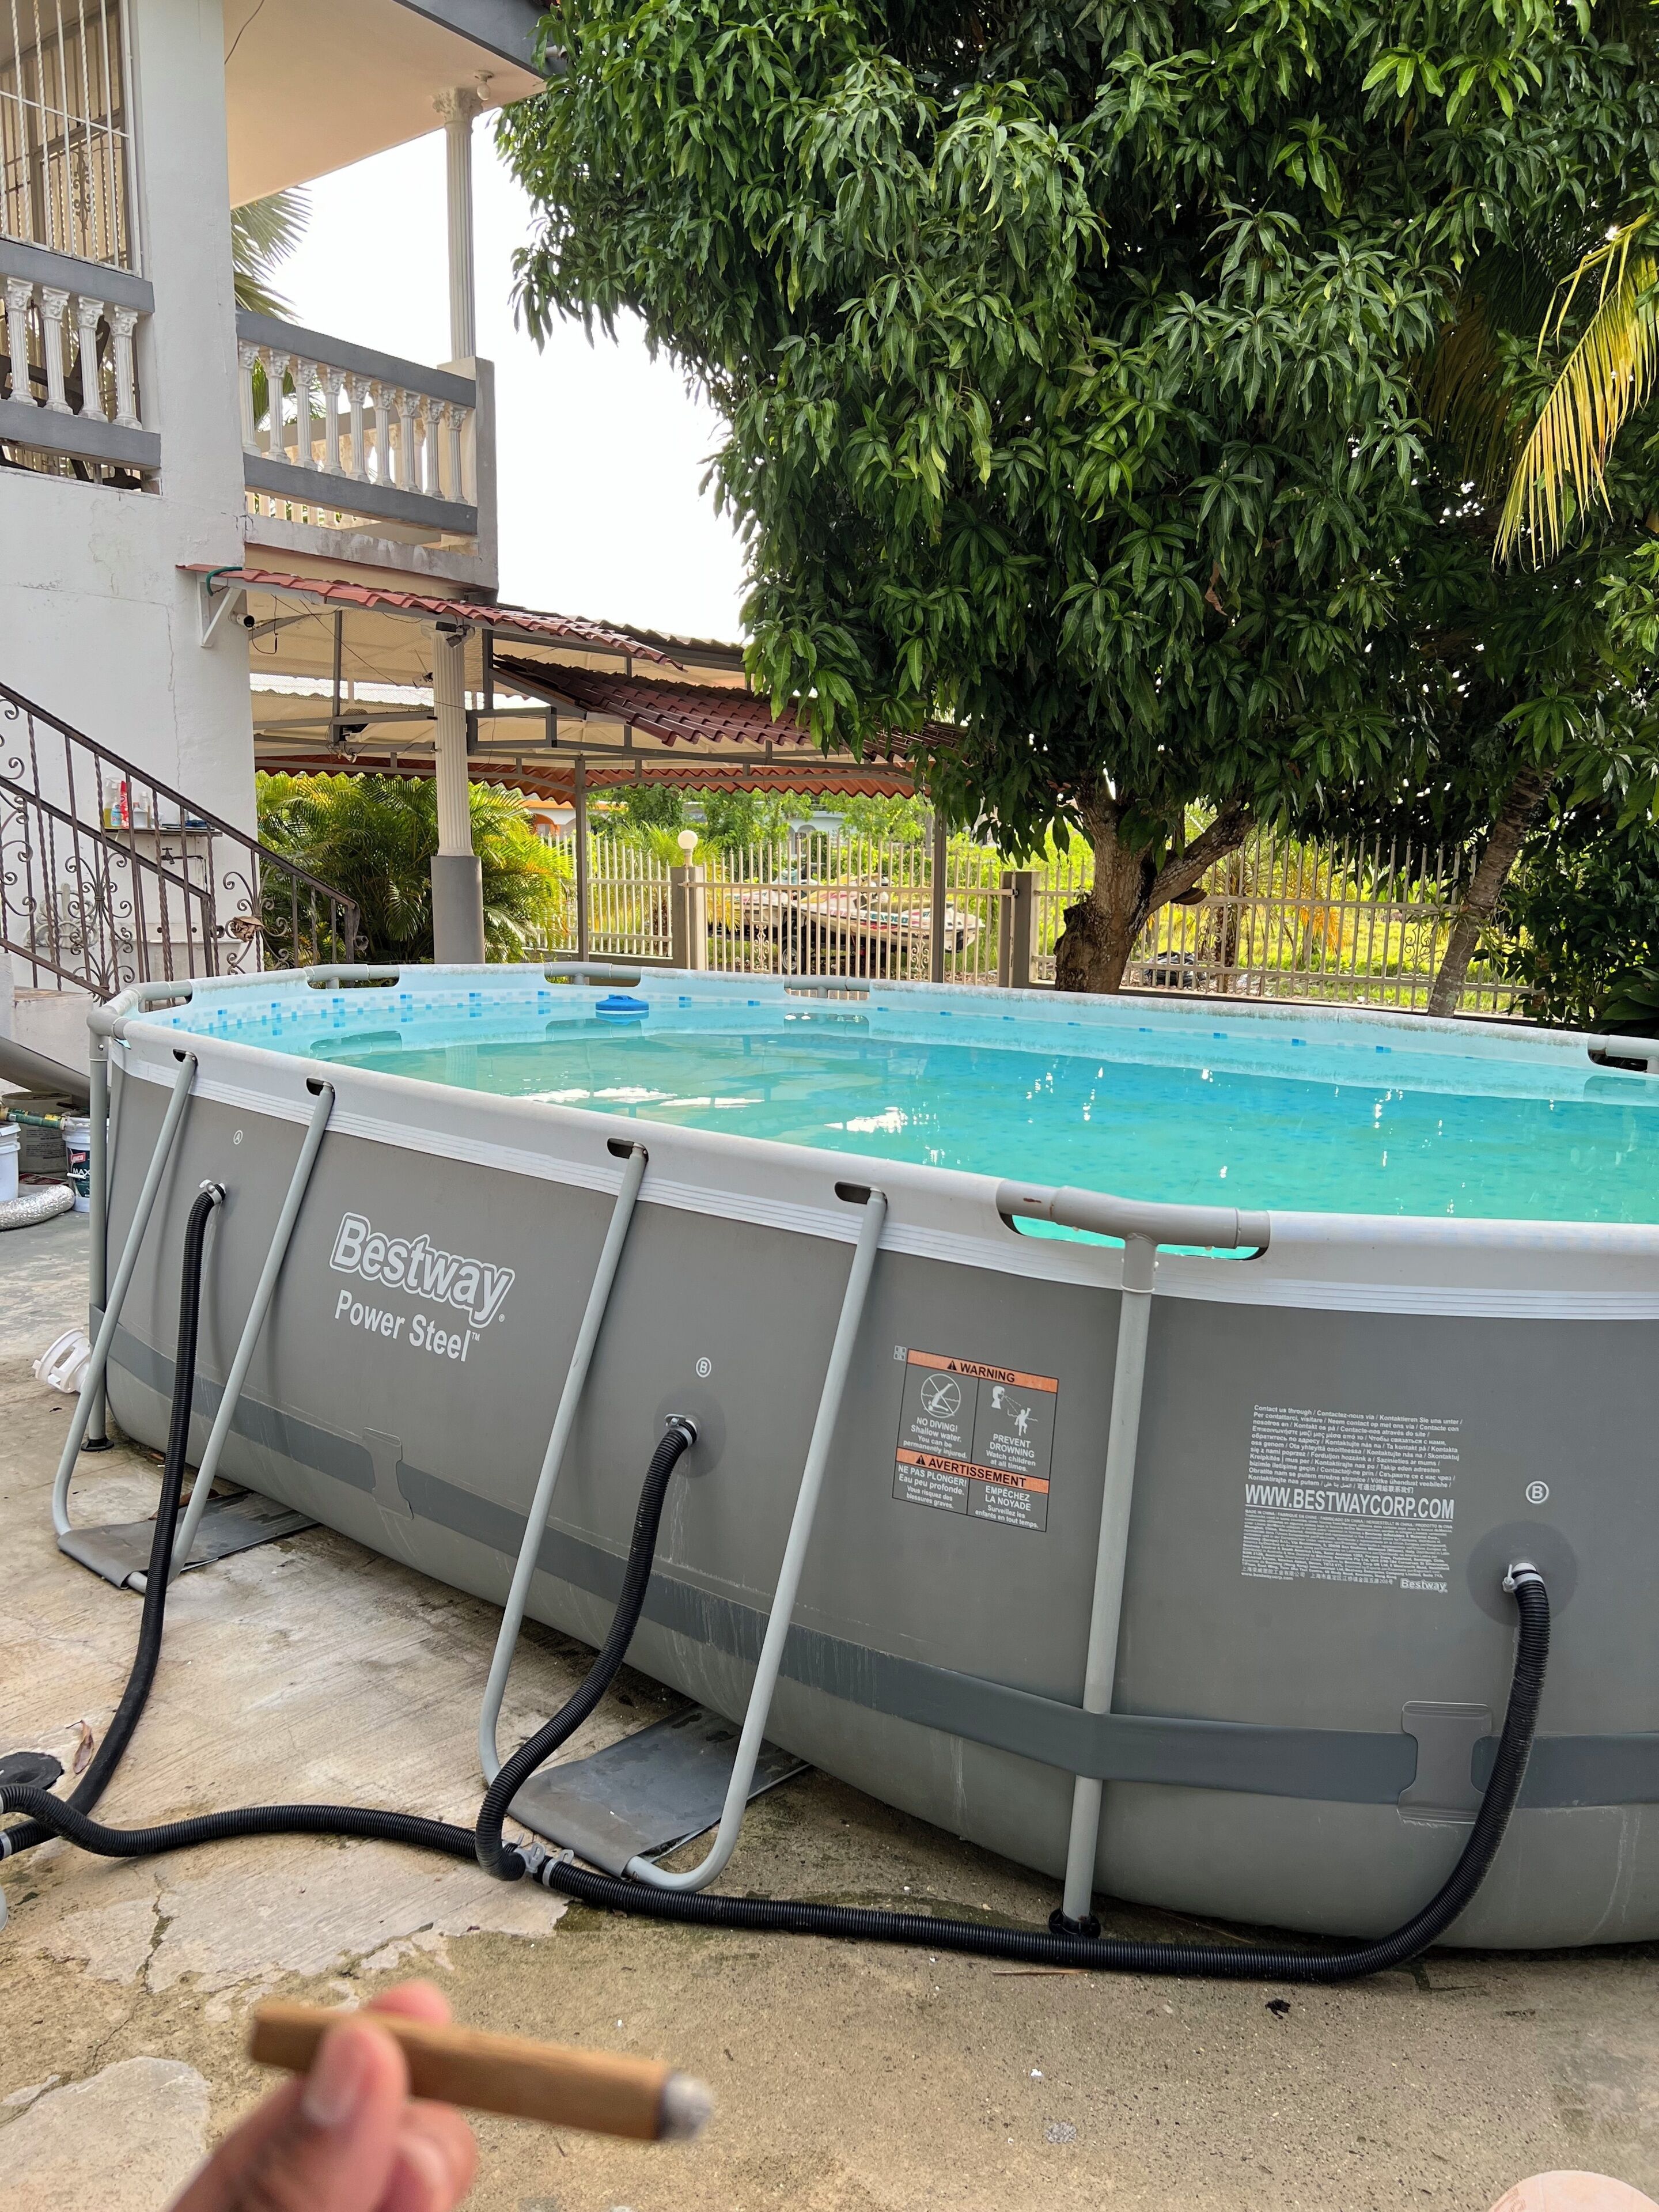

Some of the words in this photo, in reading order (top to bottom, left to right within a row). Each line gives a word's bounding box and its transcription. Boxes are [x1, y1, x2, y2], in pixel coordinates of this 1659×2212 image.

[335, 1290, 405, 1339] Power
[960, 1363, 1015, 1382] WARNING
[1287, 1407, 1312, 1415] through
[1316, 1410, 1364, 1419] Contactez-nous
[911, 1424, 939, 1437] Shallow
[940, 1431, 962, 1442] water.
[916, 1416, 928, 1426] NO
[929, 1419, 957, 1433] DIVING!
[1340, 1426, 1380, 1434] Contacte-nos
[993, 1433, 1031, 1448] PREVENT
[1325, 1439, 1359, 1447] Kontaktujte
[903, 1440, 942, 1454] permanently
[943, 1448, 967, 1459] injured.
[986, 1449, 1006, 1460] Watch
[1008, 1455, 1036, 1466] children
[989, 1441, 1035, 1458] DROWNING
[1310, 1452, 1339, 1460] Forduljon
[1366, 1449, 1401, 1457] Kontaktujte
[928, 1457, 1026, 1487] AVERTISSEMENT
[1007, 1462, 1028, 1471] times.
[1315, 1459, 1353, 1468] Kontaktirajte
[897, 1464, 908, 1474] NE
[910, 1467, 925, 1478] PAS
[926, 1471, 967, 1487] PLONGER!
[1248, 1474, 1286, 1483] Kontaktirajte
[899, 1473, 912, 1483] Eau
[914, 1478, 927, 1488] peu
[929, 1480, 964, 1496] profonde.
[907, 1485, 920, 1494] Vous
[921, 1488, 941, 1499] risquez
[942, 1493, 953, 1501] des
[985, 1483, 1030, 1502] EMPÊCHEZ
[906, 1492, 933, 1503] blessures
[933, 1499, 953, 1510] graves.
[985, 1494, 996, 1503] LA
[997, 1497, 1031, 1511] NOYADE
[1245, 1484, 1454, 1519] WWW.BESTWAYCORP.COM
[987, 1504, 1016, 1516] Surveillez
[975, 1509, 997, 1518] enfants
[1019, 1519, 1038, 1529] temps.
[1400, 1578, 1448, 1592] Bestway
